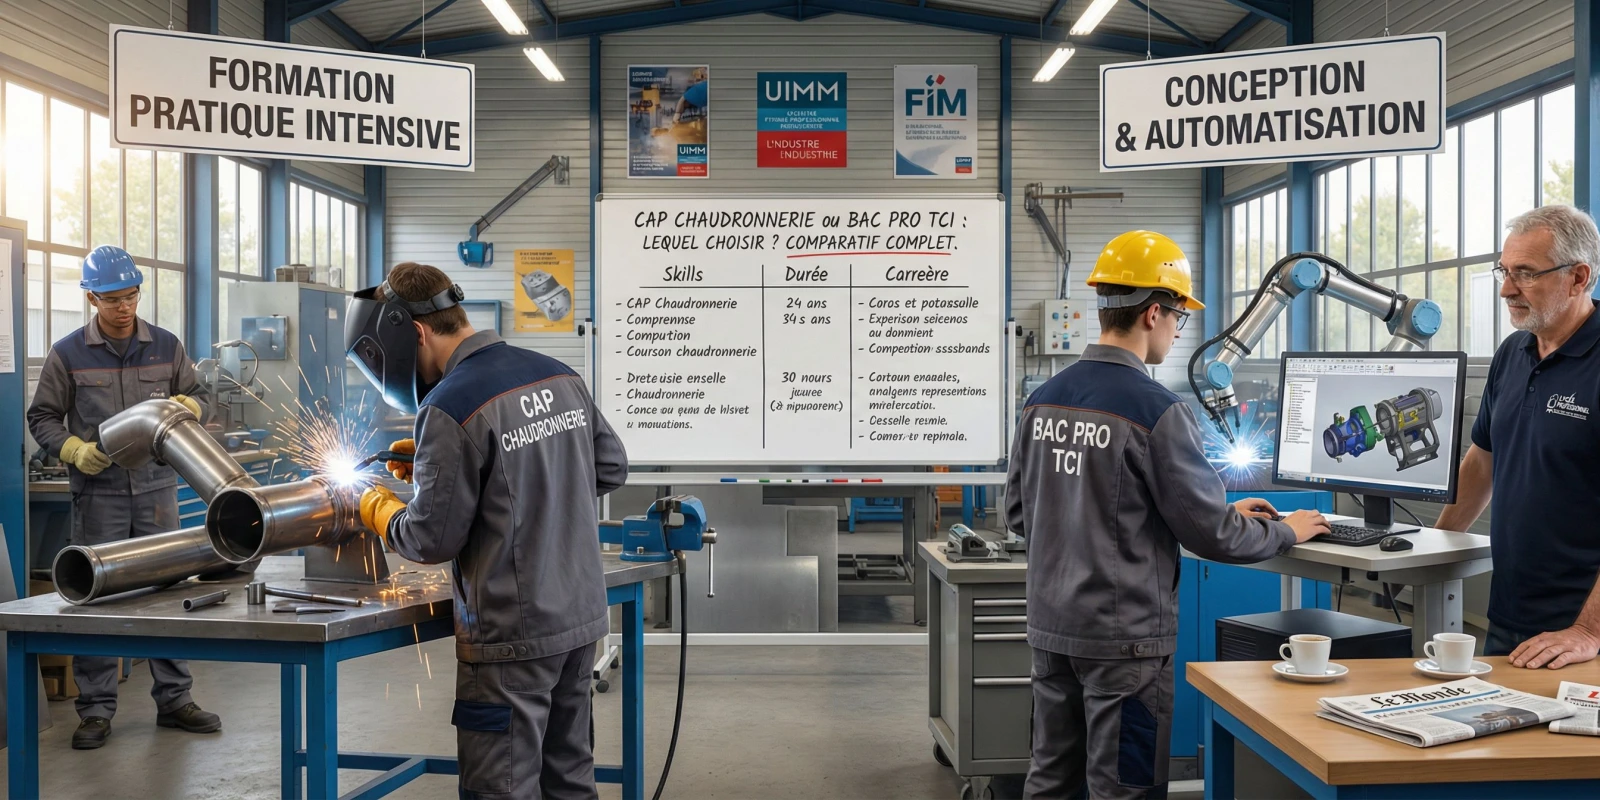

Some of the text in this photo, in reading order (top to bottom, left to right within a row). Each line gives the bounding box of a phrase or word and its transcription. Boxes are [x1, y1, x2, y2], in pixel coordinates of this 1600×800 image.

[209, 56, 394, 104] FORMATION
[1165, 60, 1365, 107] CONCEPTION
[766, 81, 838, 101] UIMM
[130, 94, 460, 151] PRATIQUE INTENSIVE
[1115, 100, 1425, 152] & AUTOMATISATION
[635, 211, 667, 227] CAP
[675, 211, 815, 227] CHAUDRONNERIE
[822, 216, 840, 227] ou
[847, 212, 880, 228] BAC
[889, 211, 921, 227] PRO
[929, 212, 954, 227] TCI
[643, 235, 698, 252] LEQUEL
[706, 235, 764, 249] CHOISIR
[786, 235, 880, 249] COMPARATIF
[886, 235, 957, 250] COMPLET.
[663, 265, 703, 281] Skills
[786, 265, 828, 281] Durée
[886, 265, 948, 281] Carreère
[627, 297, 737, 309] CAP Chaudronnerie
[787, 297, 827, 308] 24 ans
[869, 297, 900, 308] Coros
[905, 298, 917, 308] et
[627, 314, 695, 328] Comprennse
[811, 316, 830, 324] ans
[869, 313, 919, 328] Experison
[627, 330, 690, 344] Compution
[627, 345, 757, 356] Courson chaudronnerie
[687, 372, 726, 383] enselle
[782, 372, 796, 382] 30
[627, 388, 705, 399] Chaudronnerie
[922, 387, 986, 398] representions
[520, 389, 553, 418] CAP
[627, 405, 657, 414] Conce
[704, 404, 716, 414] de
[502, 409, 587, 451] CHAUDRONNERIE
[1033, 418, 1110, 448] BAC PRO
[1052, 449, 1082, 476] TCI
[1371, 695, 1397, 709] Le
[1399, 685, 1470, 706] Monde
